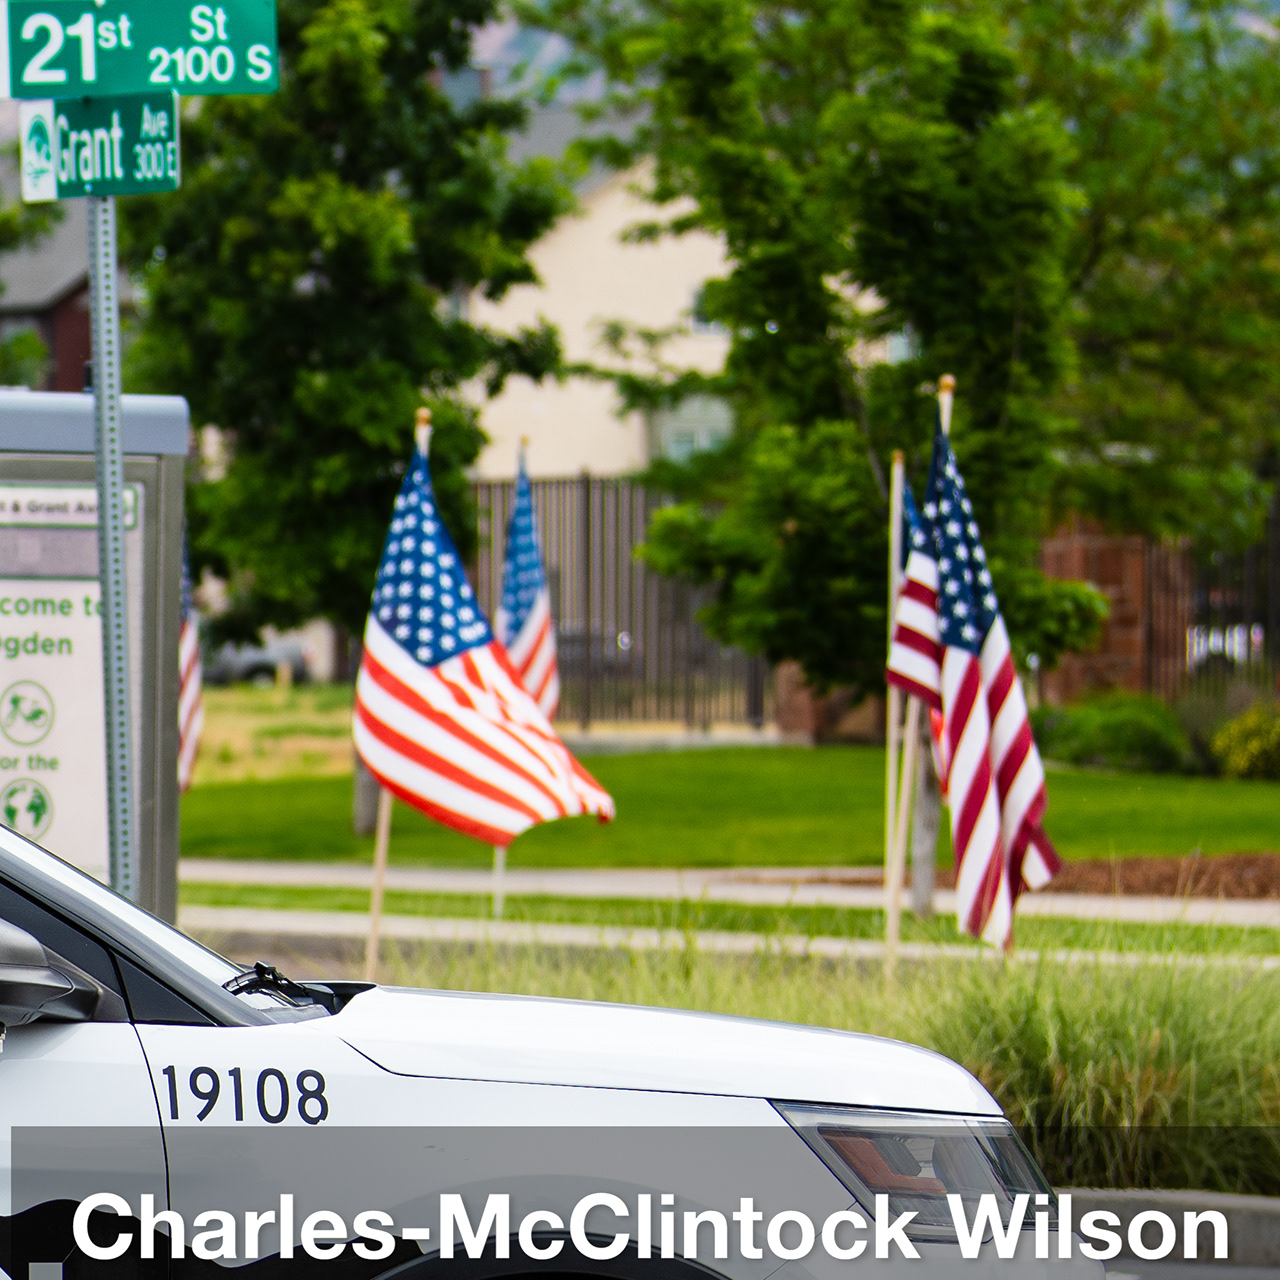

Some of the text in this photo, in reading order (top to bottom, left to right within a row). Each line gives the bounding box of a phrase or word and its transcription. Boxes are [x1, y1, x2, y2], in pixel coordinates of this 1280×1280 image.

[20, 4, 228, 84] 21st St
[148, 44, 273, 84] 2100 S
[55, 110, 124, 183] Grant
[141, 103, 169, 139] Ave
[12, 499, 21, 513] &
[27, 499, 70, 514] Grant
[75, 499, 97, 513] Av
[28, 753, 59, 770] the
[161, 1065, 329, 1125] 19108
